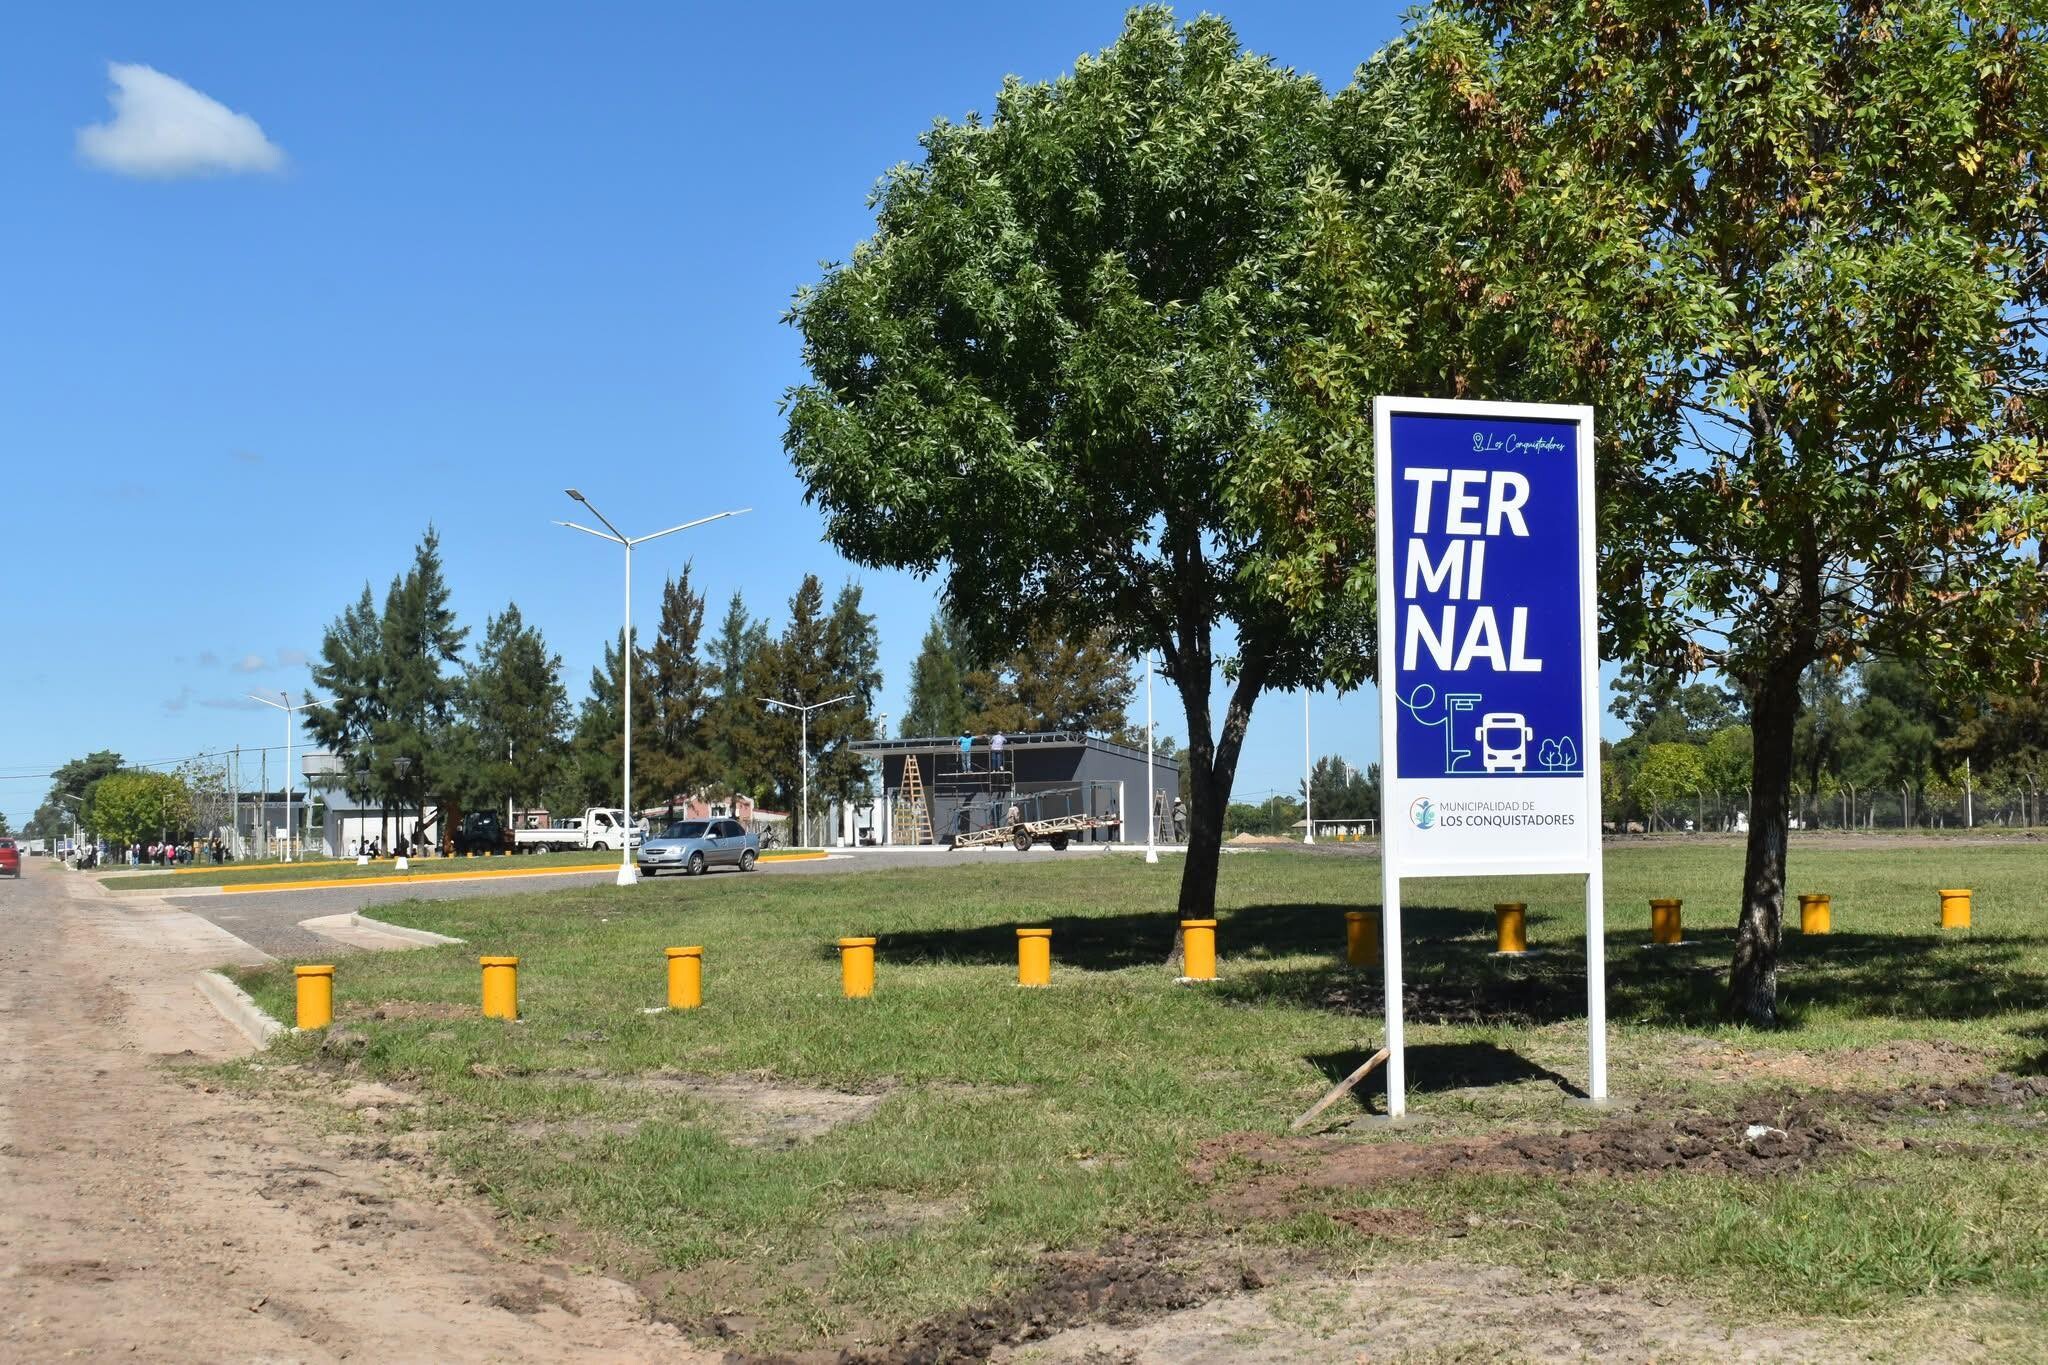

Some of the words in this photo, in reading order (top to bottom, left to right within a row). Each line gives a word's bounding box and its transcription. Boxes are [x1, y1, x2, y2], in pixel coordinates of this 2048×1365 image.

[1484, 433, 1503, 451] Los
[1505, 433, 1565, 455] Conquistadores
[1404, 467, 1530, 537] TER
[1404, 538, 1486, 600] MI
[1403, 604, 1543, 672] NAL
[1439, 801, 1519, 812] MUNICIPALIDAD
[1522, 801, 1535, 811] DE
[1440, 815, 1463, 827] LOS
[1465, 814, 1575, 828] CONQUISTADORES
